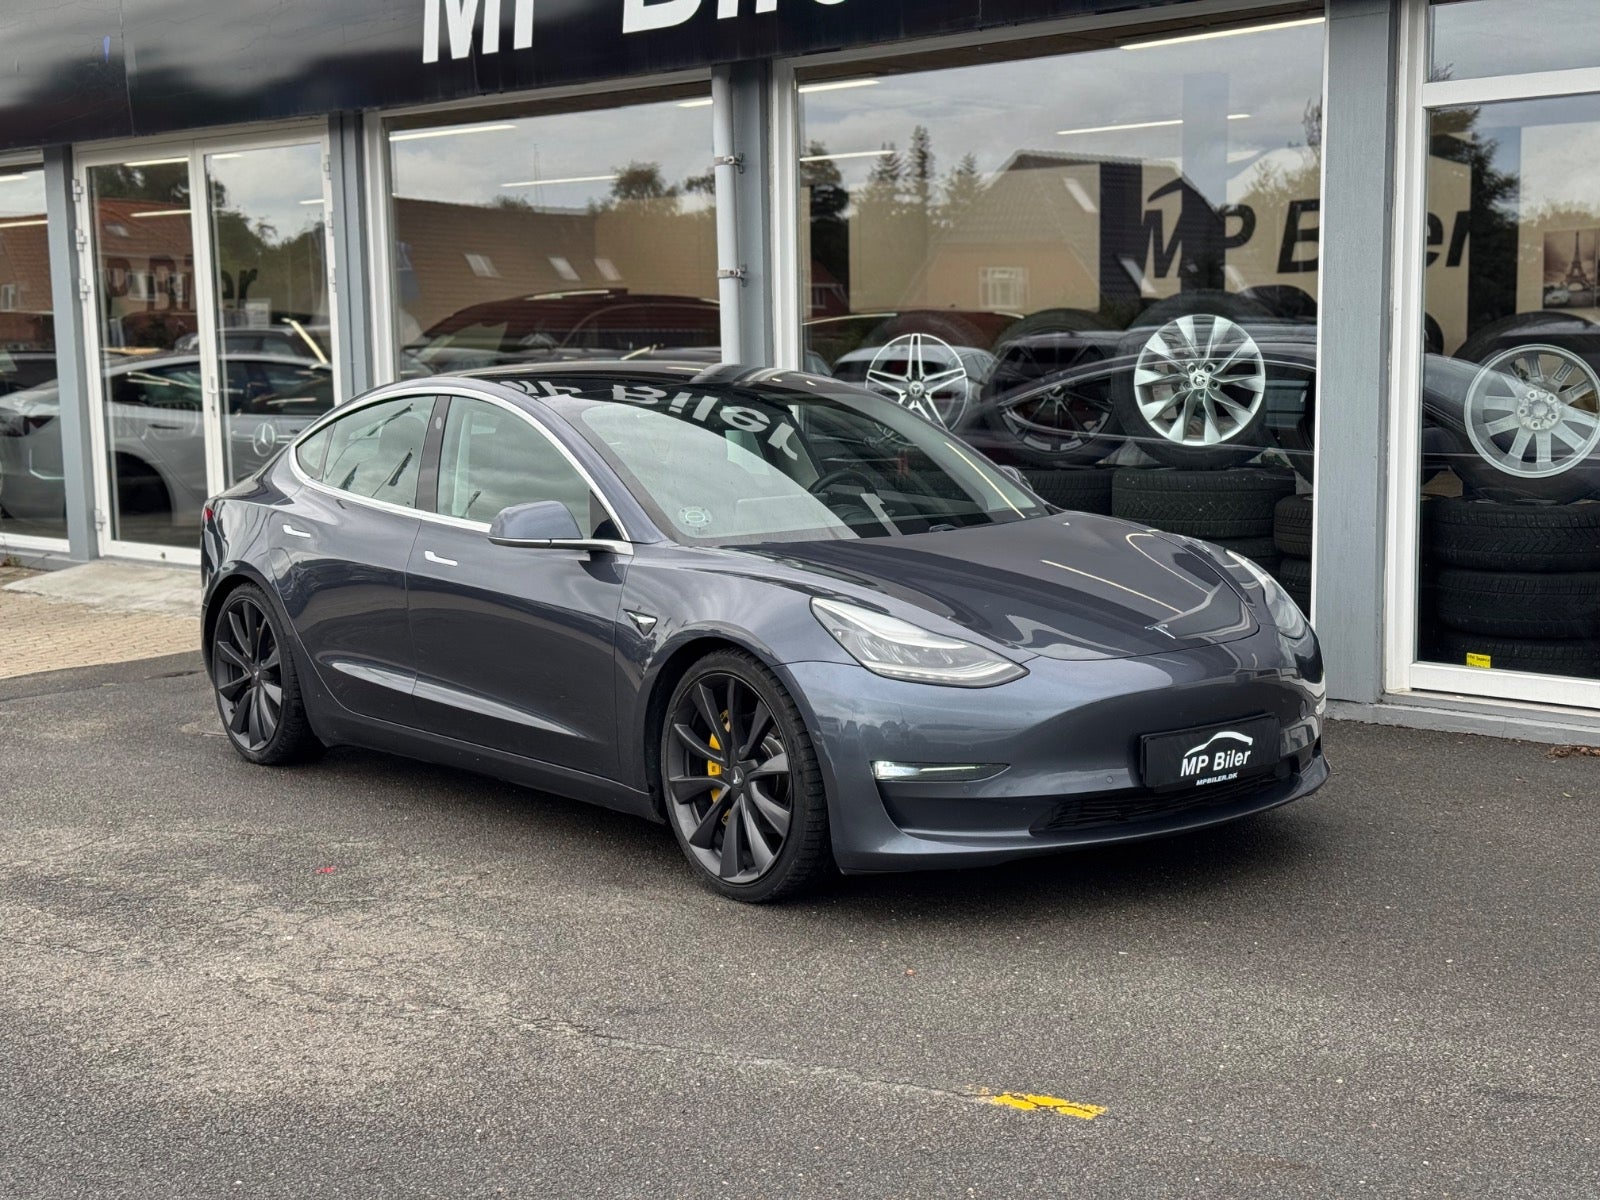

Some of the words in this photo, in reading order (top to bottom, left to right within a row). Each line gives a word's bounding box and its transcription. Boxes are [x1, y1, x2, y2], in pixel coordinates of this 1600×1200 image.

[1180, 755, 1209, 777] MP
[1213, 749, 1251, 771] Biler
[1195, 772, 1238, 786] MPBILER.DK
